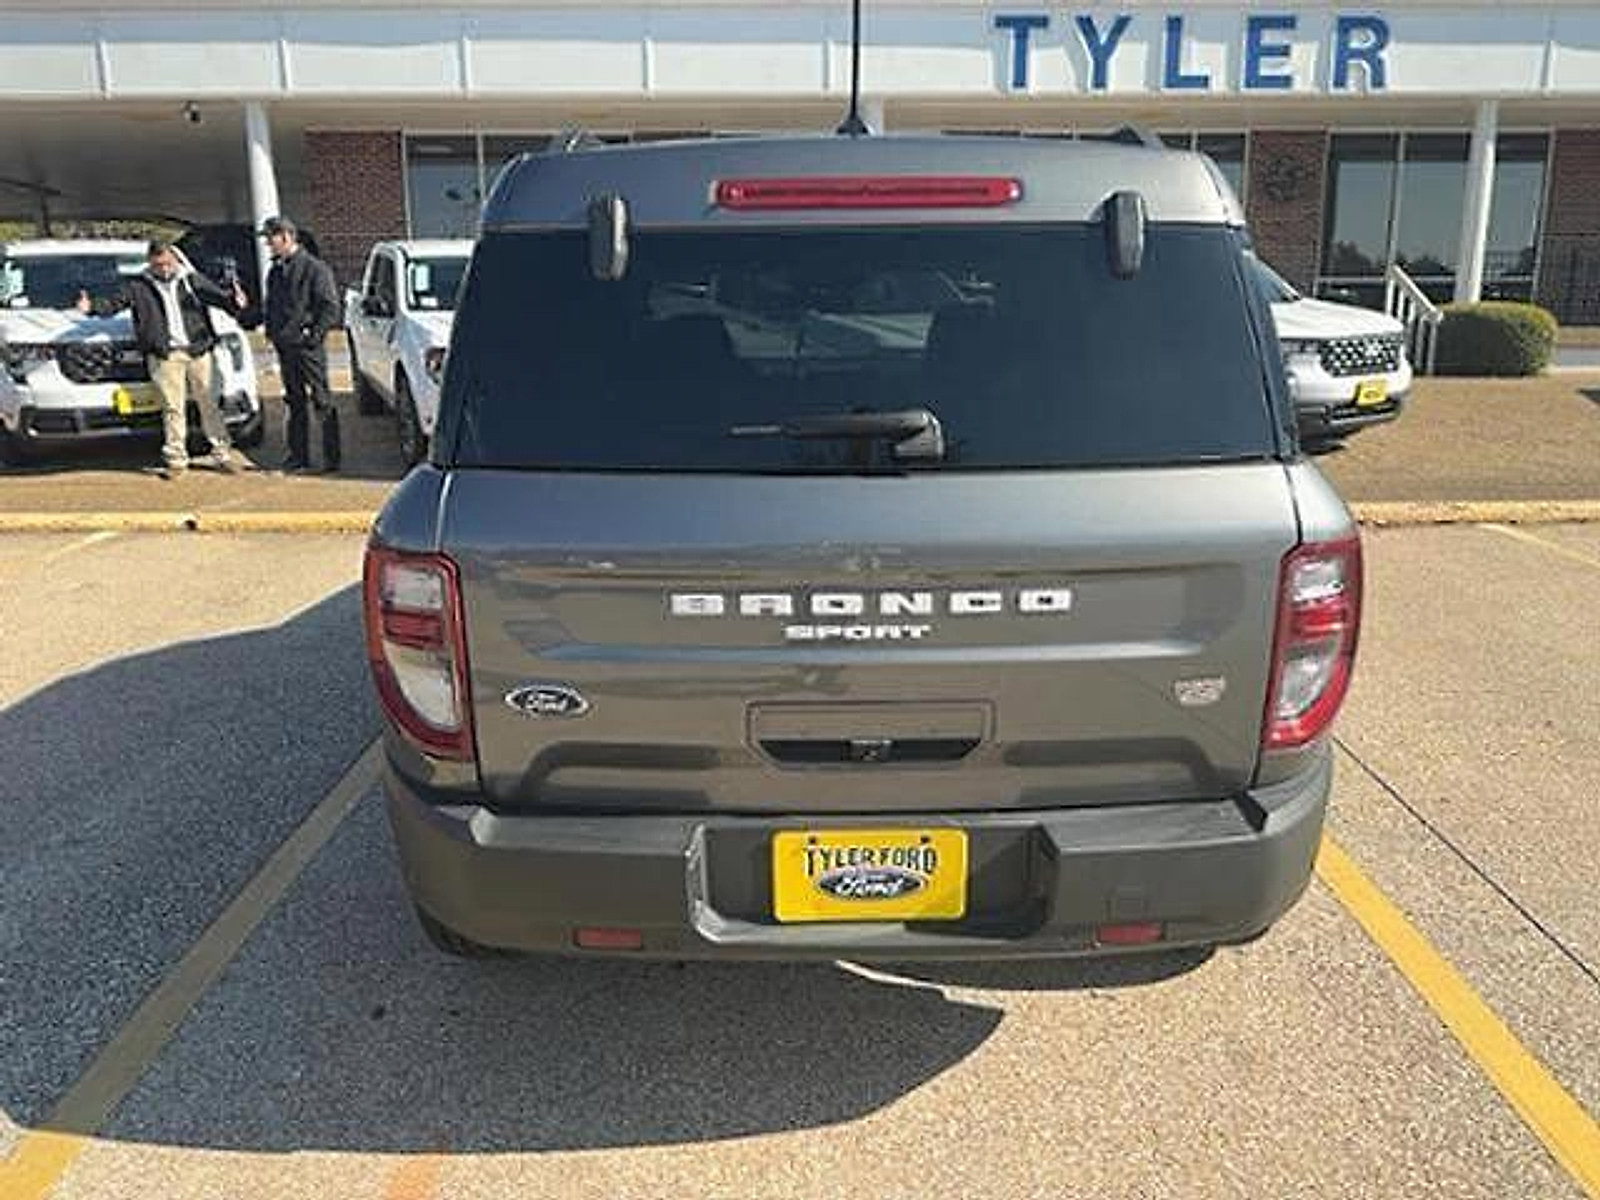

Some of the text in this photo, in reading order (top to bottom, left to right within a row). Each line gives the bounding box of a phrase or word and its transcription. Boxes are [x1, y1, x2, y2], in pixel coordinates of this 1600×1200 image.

[994, 13, 1391, 91] TYLER
[670, 589, 1073, 615] BRONCO
[784, 623, 932, 640] SPORT
[803, 846, 938, 876] TYLER FORD
[833, 873, 906, 899] Ford
